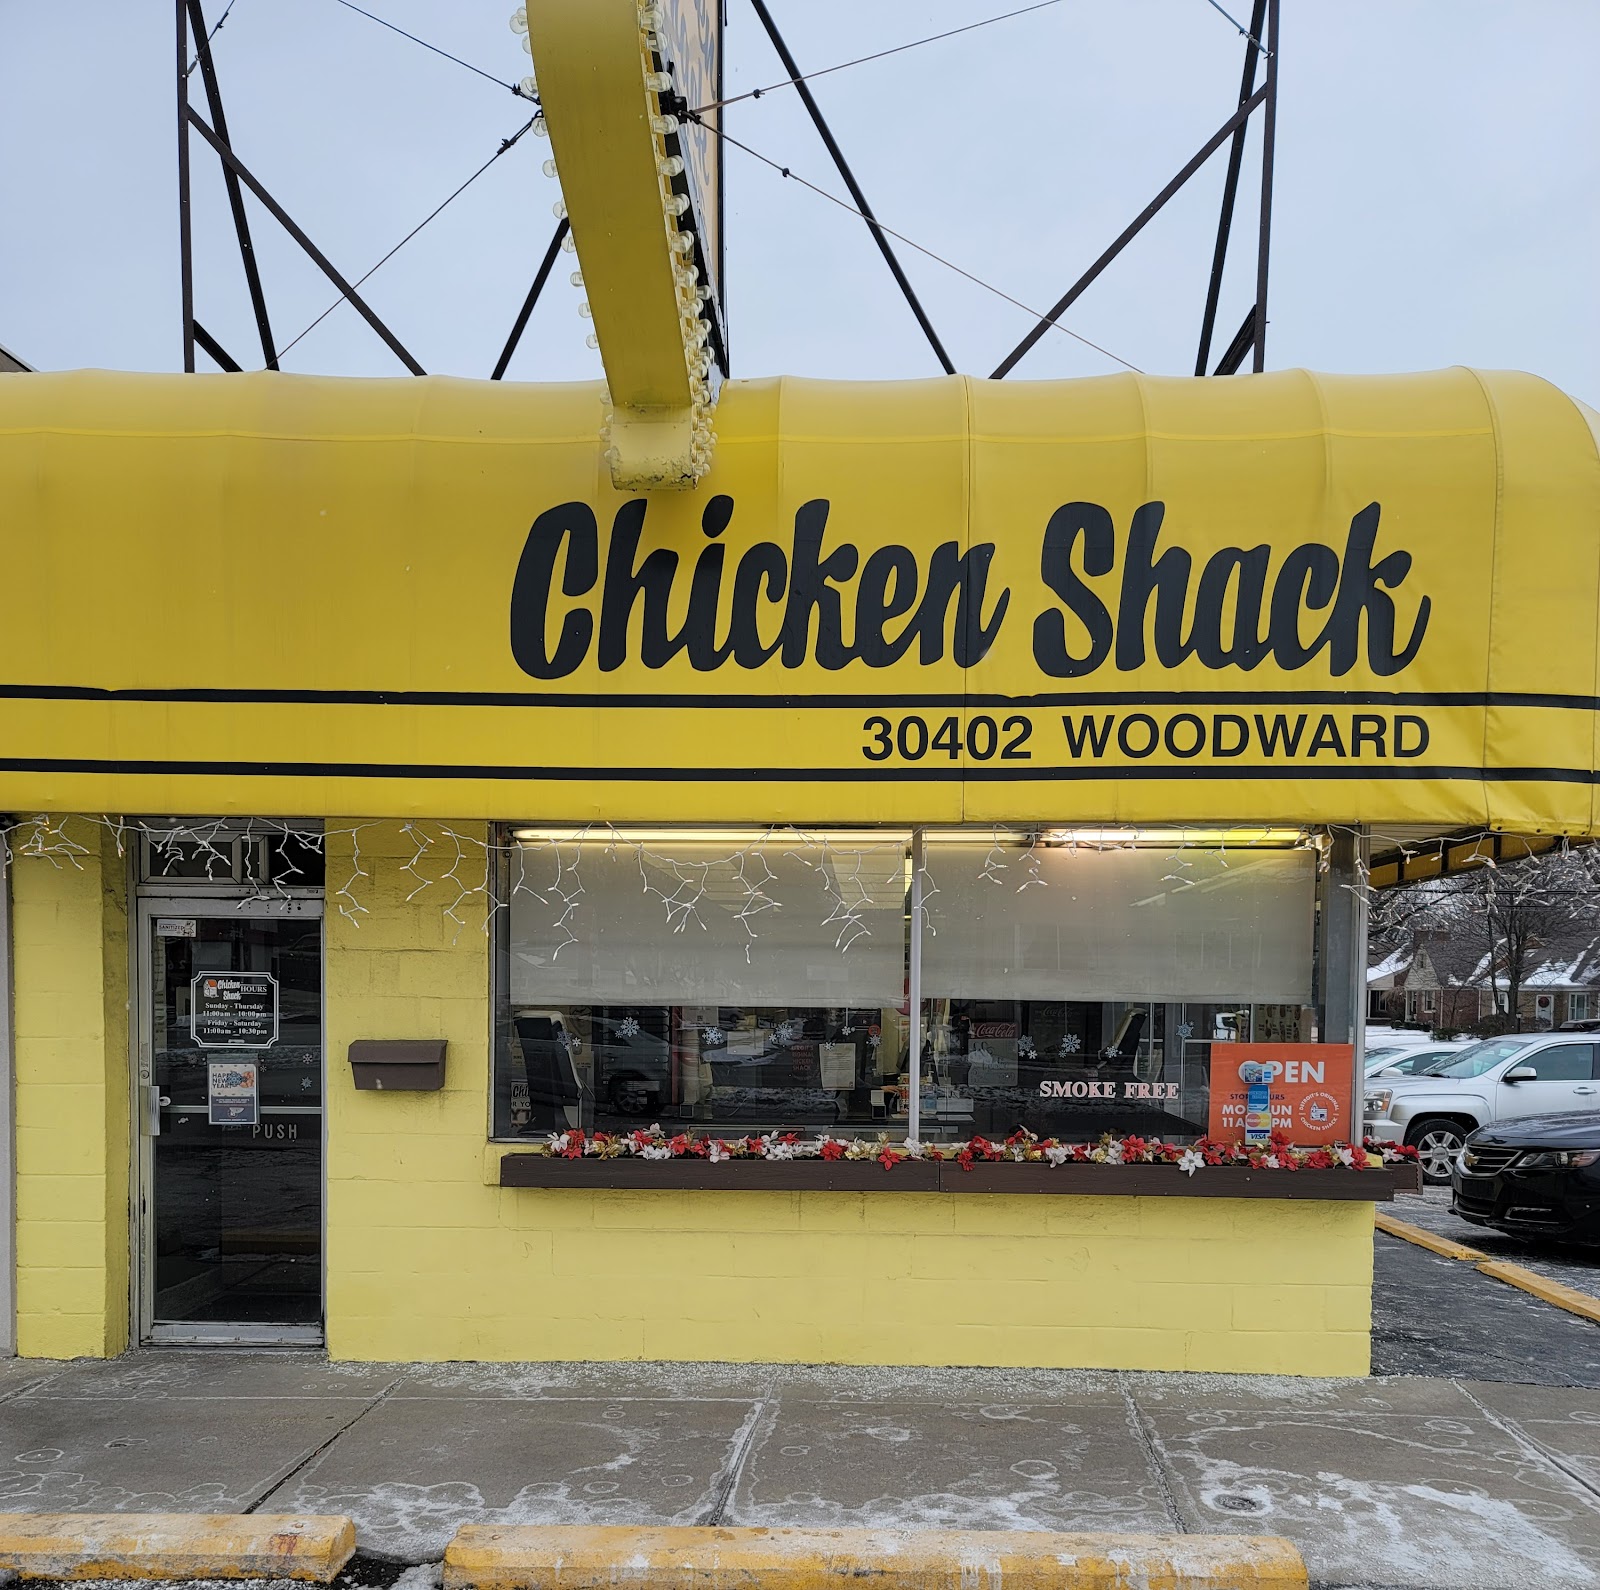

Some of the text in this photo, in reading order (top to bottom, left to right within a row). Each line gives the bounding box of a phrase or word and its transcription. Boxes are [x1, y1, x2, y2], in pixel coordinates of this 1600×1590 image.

[511, 495, 1431, 679] Chicken Shack
[862, 714, 1430, 760] 30402 WOODWARD
[217, 980, 240, 990] Chicken
[223, 991, 242, 1000] Shack
[234, 1003, 263, 1011] Thursday
[233, 1020, 262, 1028] Saturday
[1039, 1080, 1179, 1099] SMOKE FREE
[1299, 1092, 1339, 1111] DETROIT'S ORIGINAL
[252, 1123, 297, 1139] PUSH
[1300, 1117, 1338, 1131] CHICKEN SHACK
